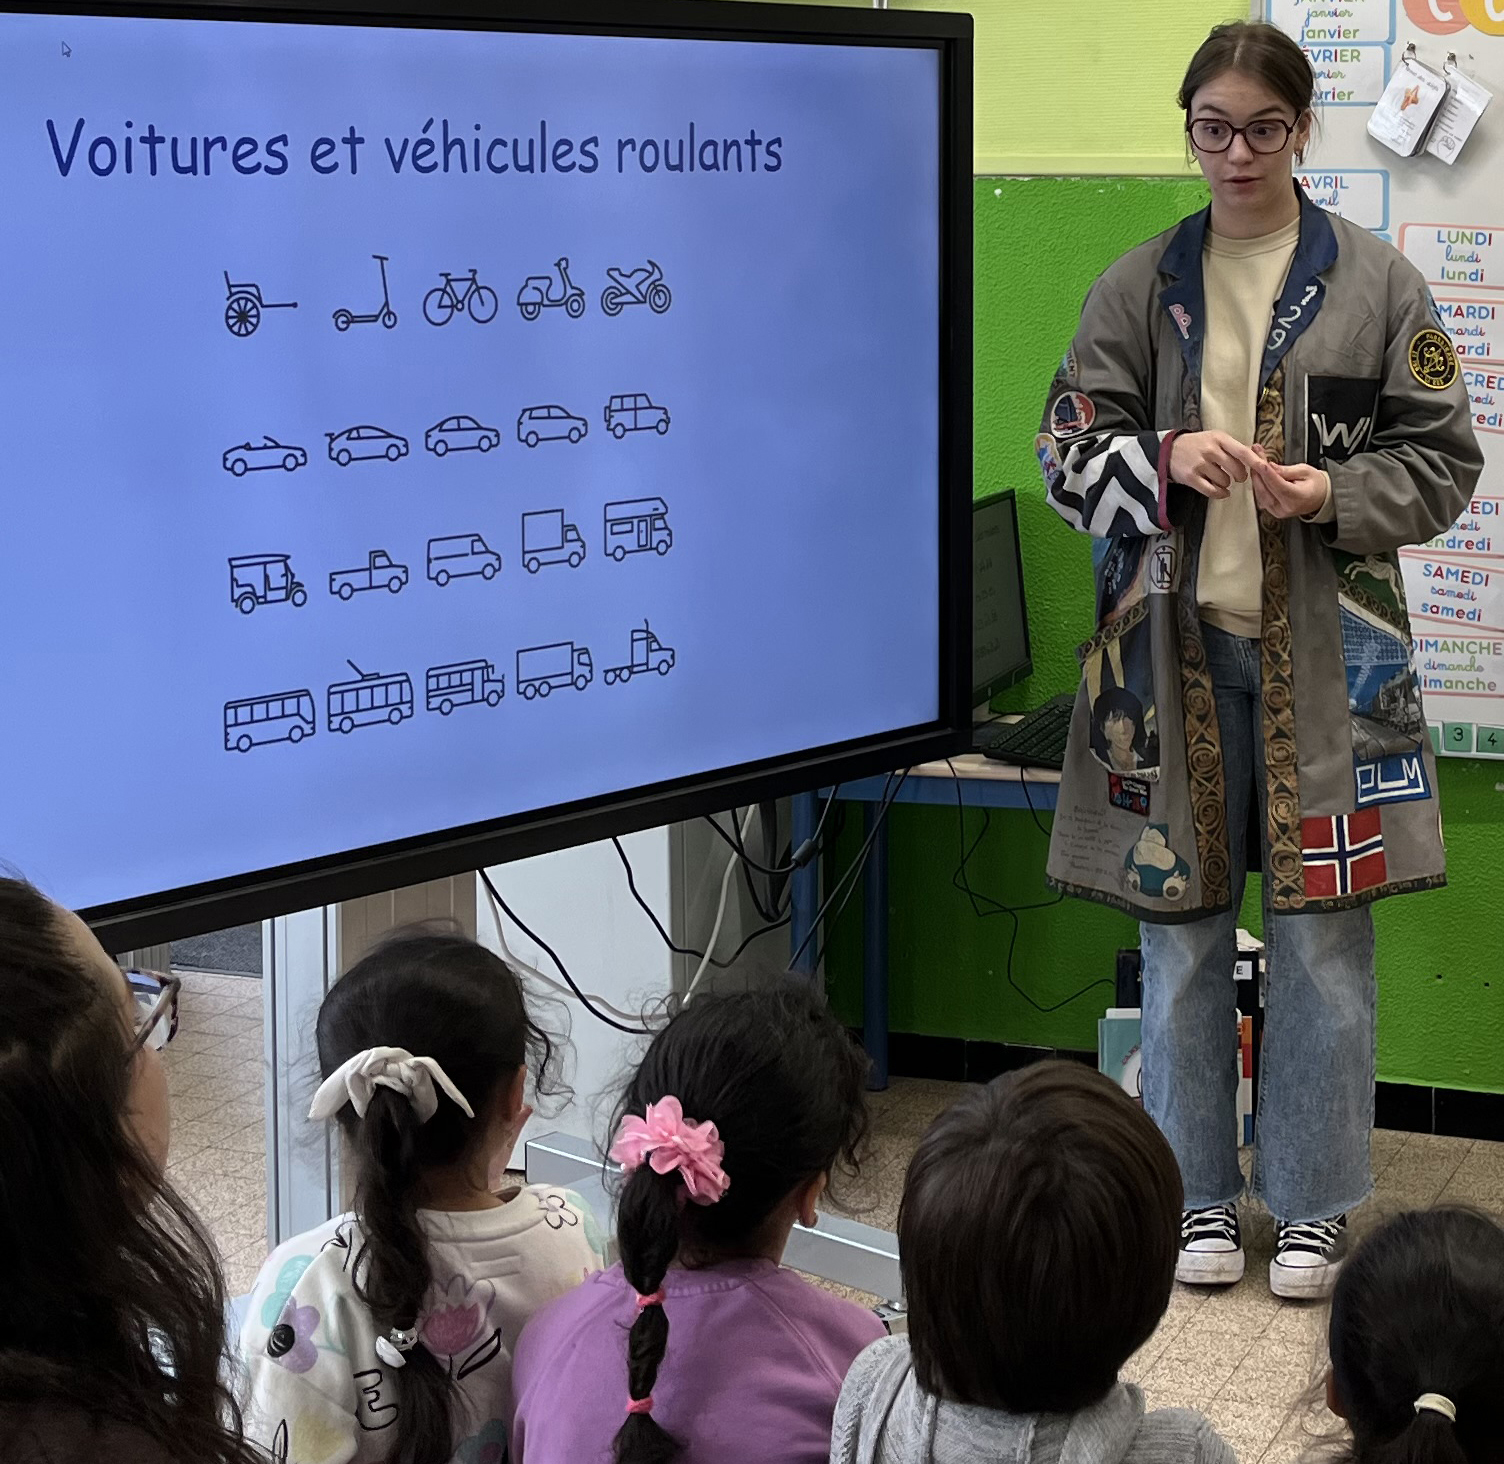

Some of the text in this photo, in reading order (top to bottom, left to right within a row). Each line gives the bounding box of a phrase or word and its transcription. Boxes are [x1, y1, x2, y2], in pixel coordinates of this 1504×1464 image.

[1301, 45, 1361, 63] ÉVRIER
[46, 117, 783, 177] Voitures et véhicules roulants
[1301, 175, 1350, 190] AVRIL
[1311, 189, 1340, 207] vril
[1437, 230, 1493, 247] LUNDI
[1445, 245, 1482, 264] lundi
[1440, 266, 1485, 283] lundi
[1439, 304, 1495, 320] MARDI
[1455, 342, 1491, 357] ardi
[1424, 536, 1492, 552] endredi
[1422, 563, 1490, 588] SAMEDI
[1430, 585, 1478, 602] samedi
[1421, 602, 1482, 623] samedi
[1423, 655, 1485, 673] dimanche
[1420, 674, 1497, 692] imanche
[1453, 727, 1464, 742] 3
[1487, 732, 1498, 746] 4
